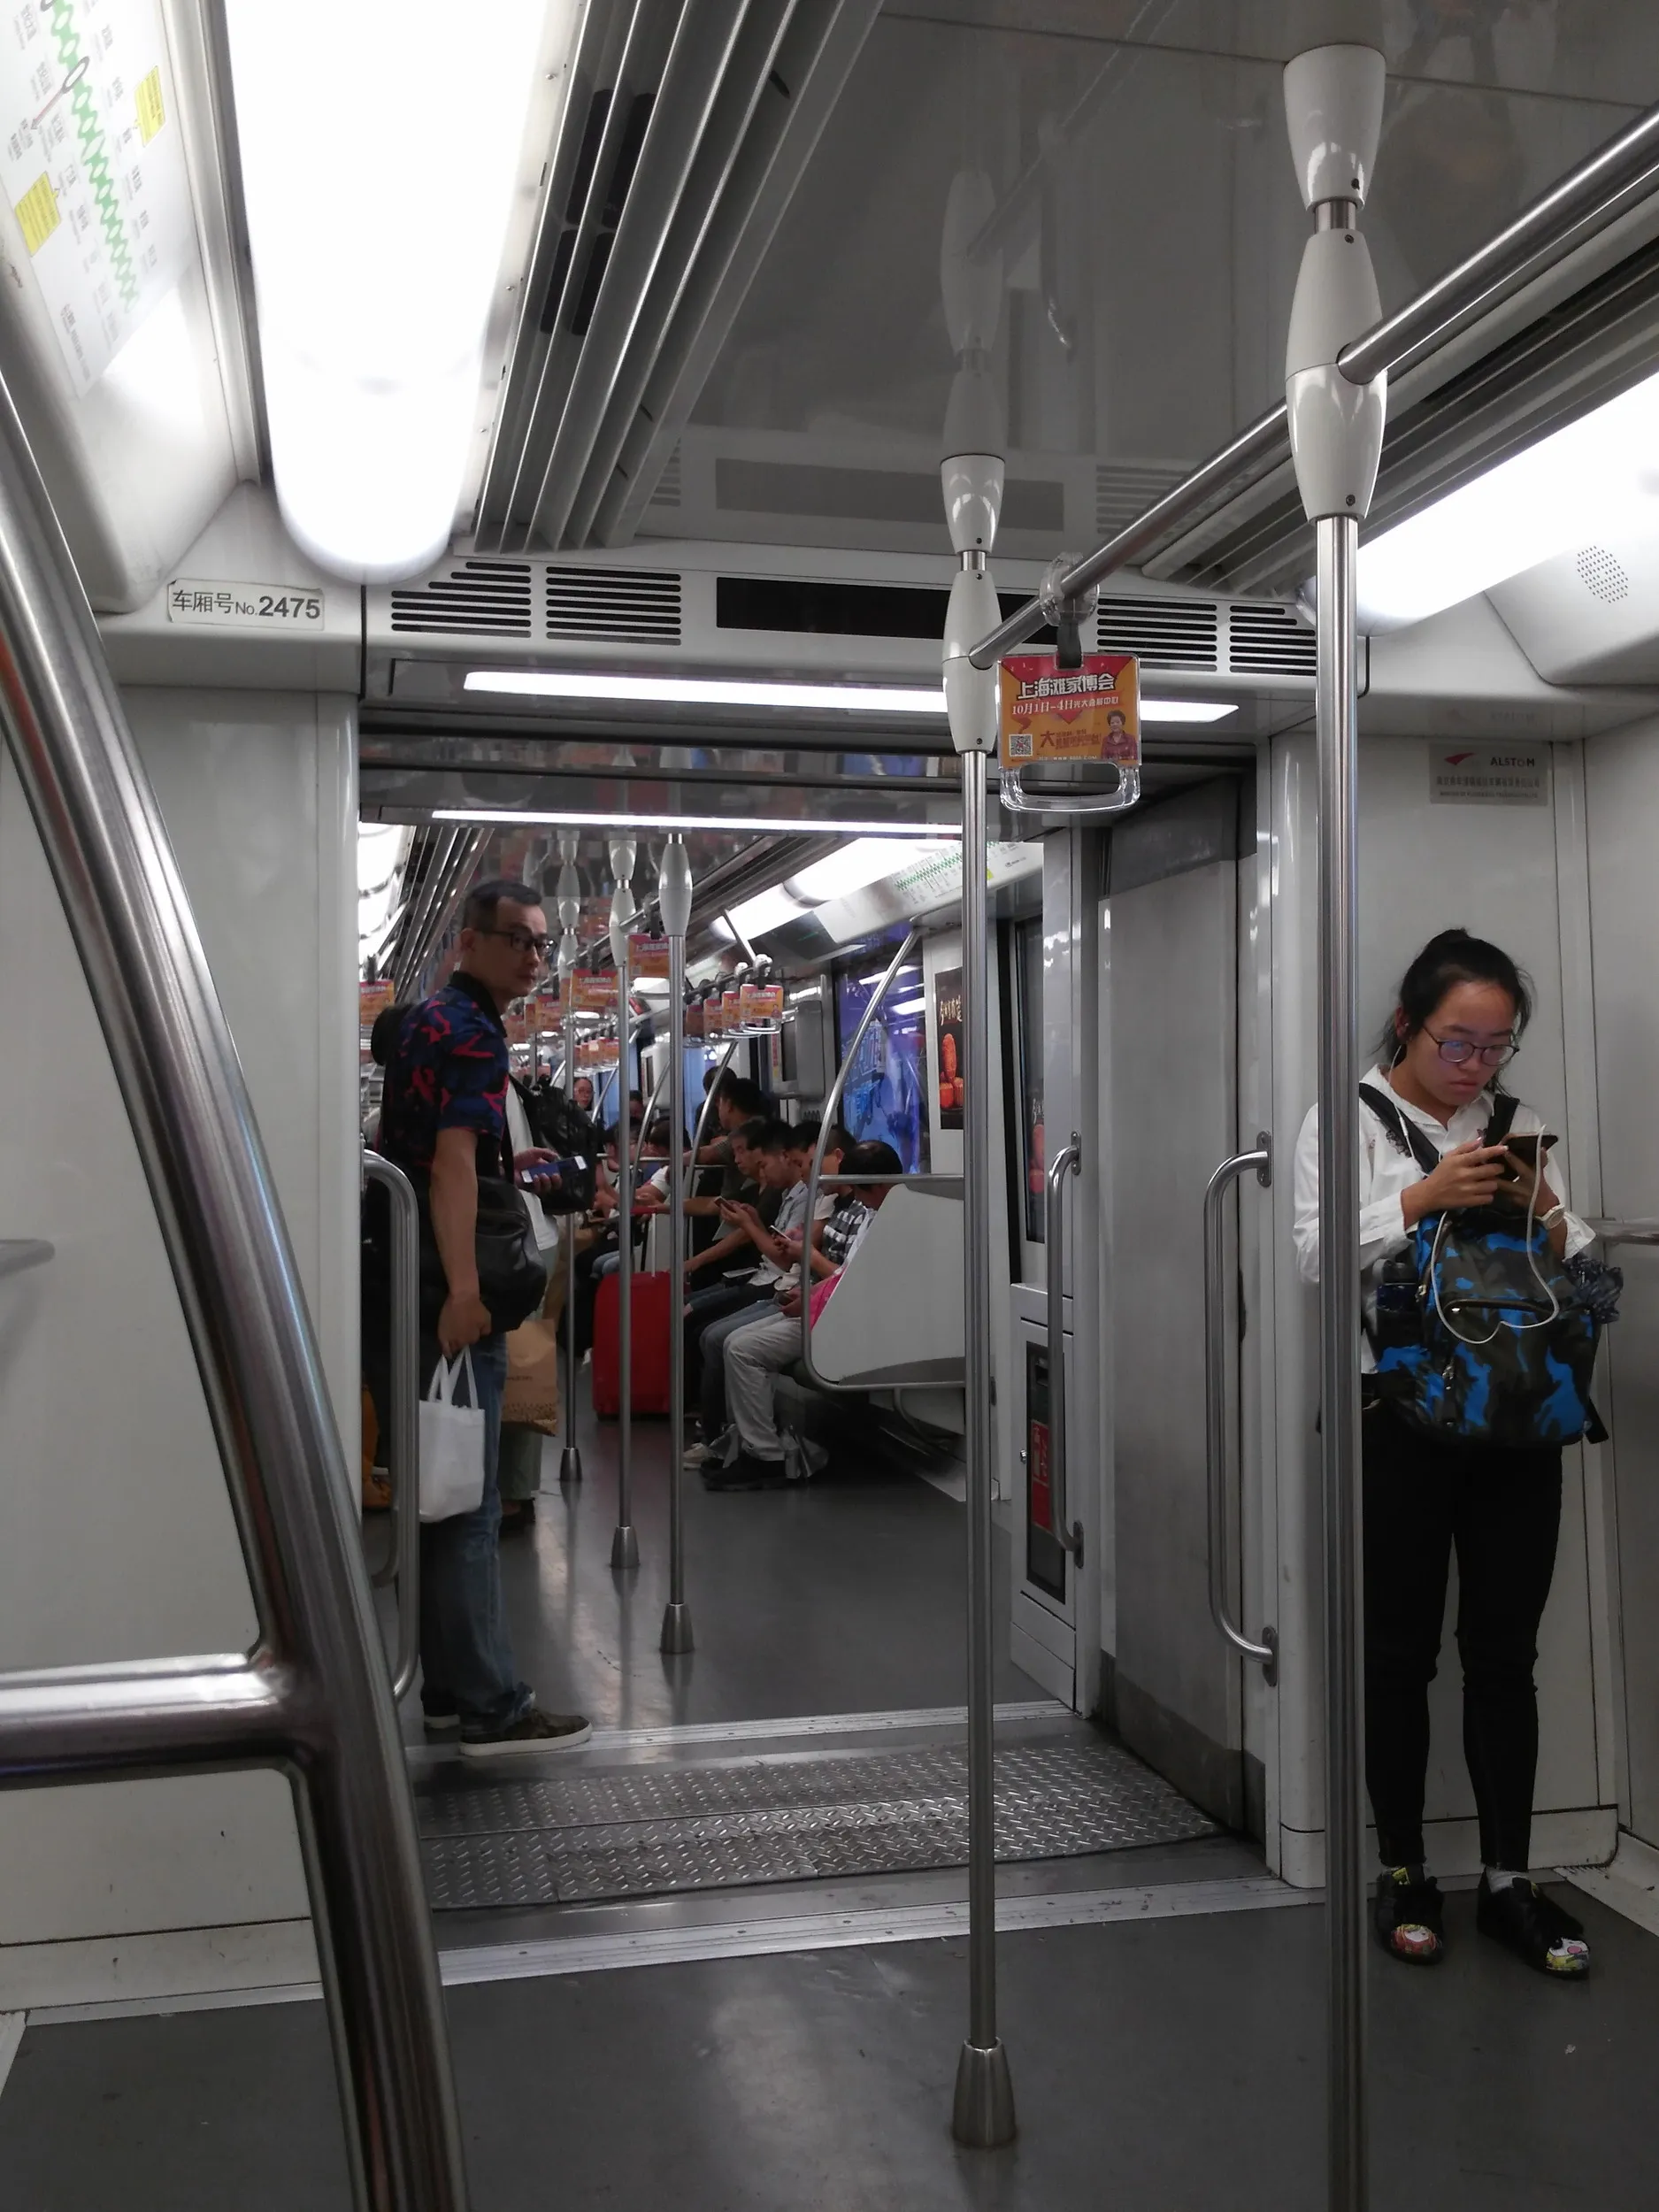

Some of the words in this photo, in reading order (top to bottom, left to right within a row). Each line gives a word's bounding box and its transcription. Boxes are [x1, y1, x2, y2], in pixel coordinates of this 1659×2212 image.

[1018, 672, 1115, 699] 上海滩家博会
